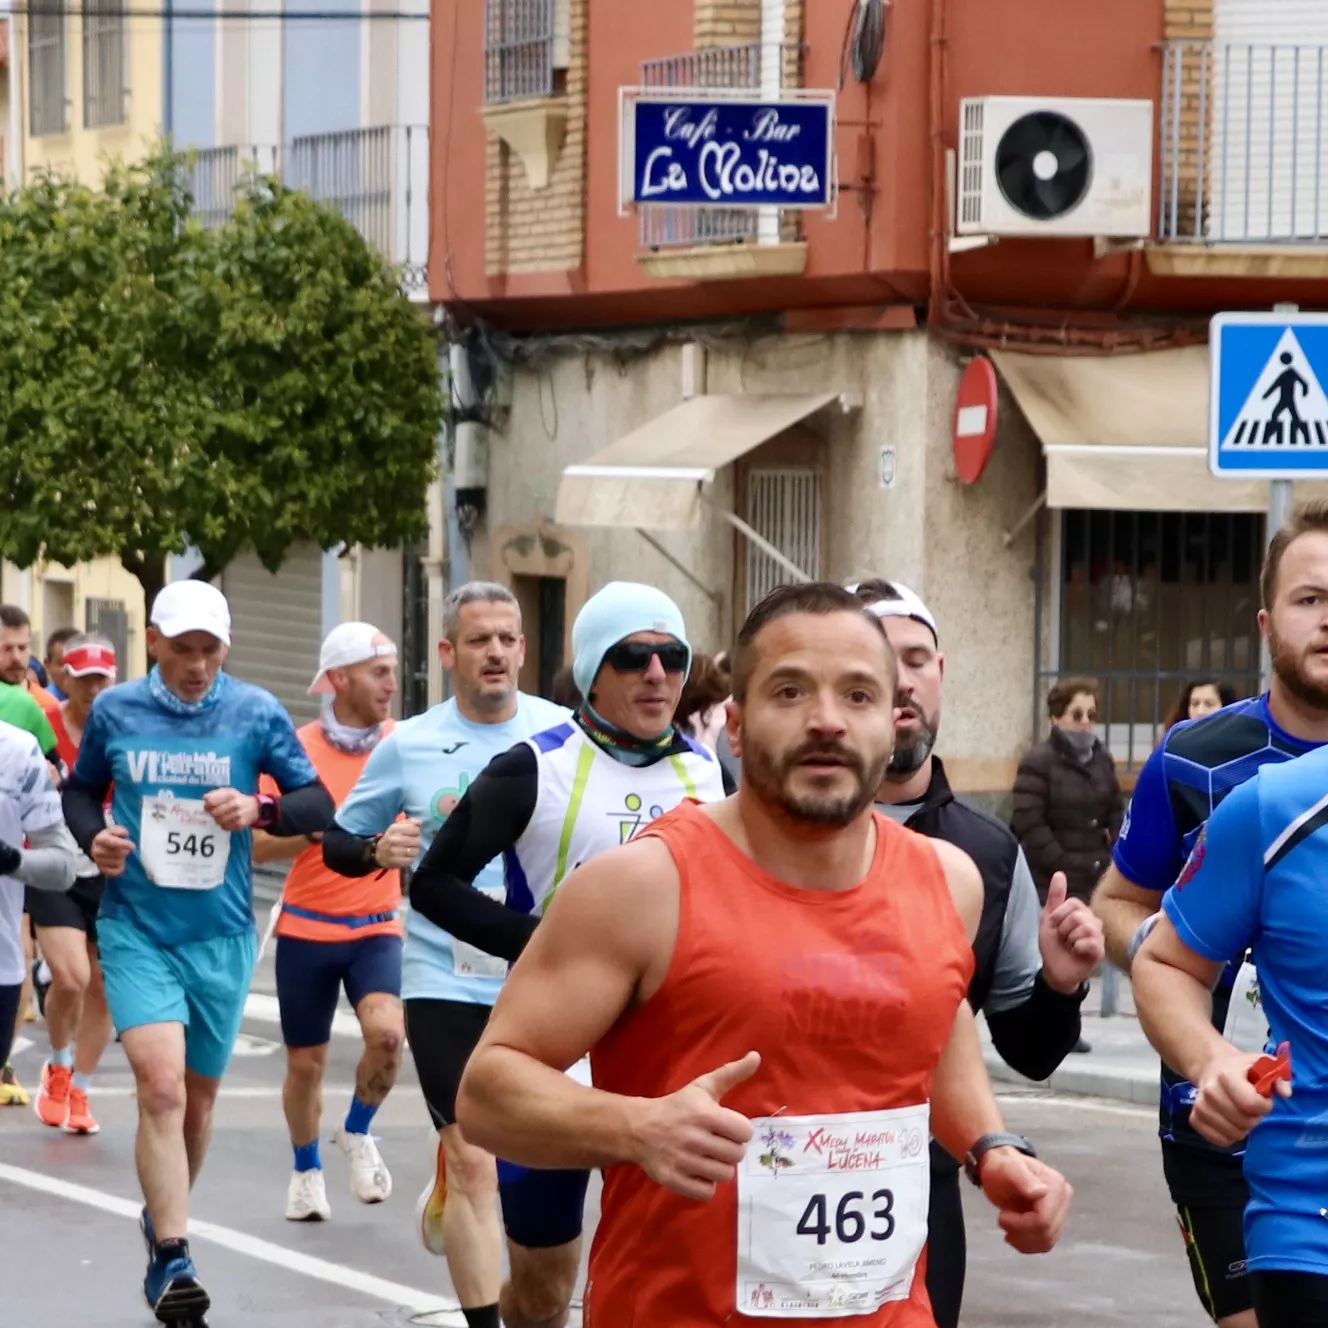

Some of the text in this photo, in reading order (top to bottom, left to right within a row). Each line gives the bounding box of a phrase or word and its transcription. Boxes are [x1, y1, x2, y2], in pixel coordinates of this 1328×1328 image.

[661, 107, 801, 148] Café Bar
[640, 140, 820, 200] La Molina
[126, 750, 158, 783] VI
[167, 831, 215, 858] 546
[826, 1150, 886, 1170] LUCENA
[796, 1188, 896, 1245] 463
